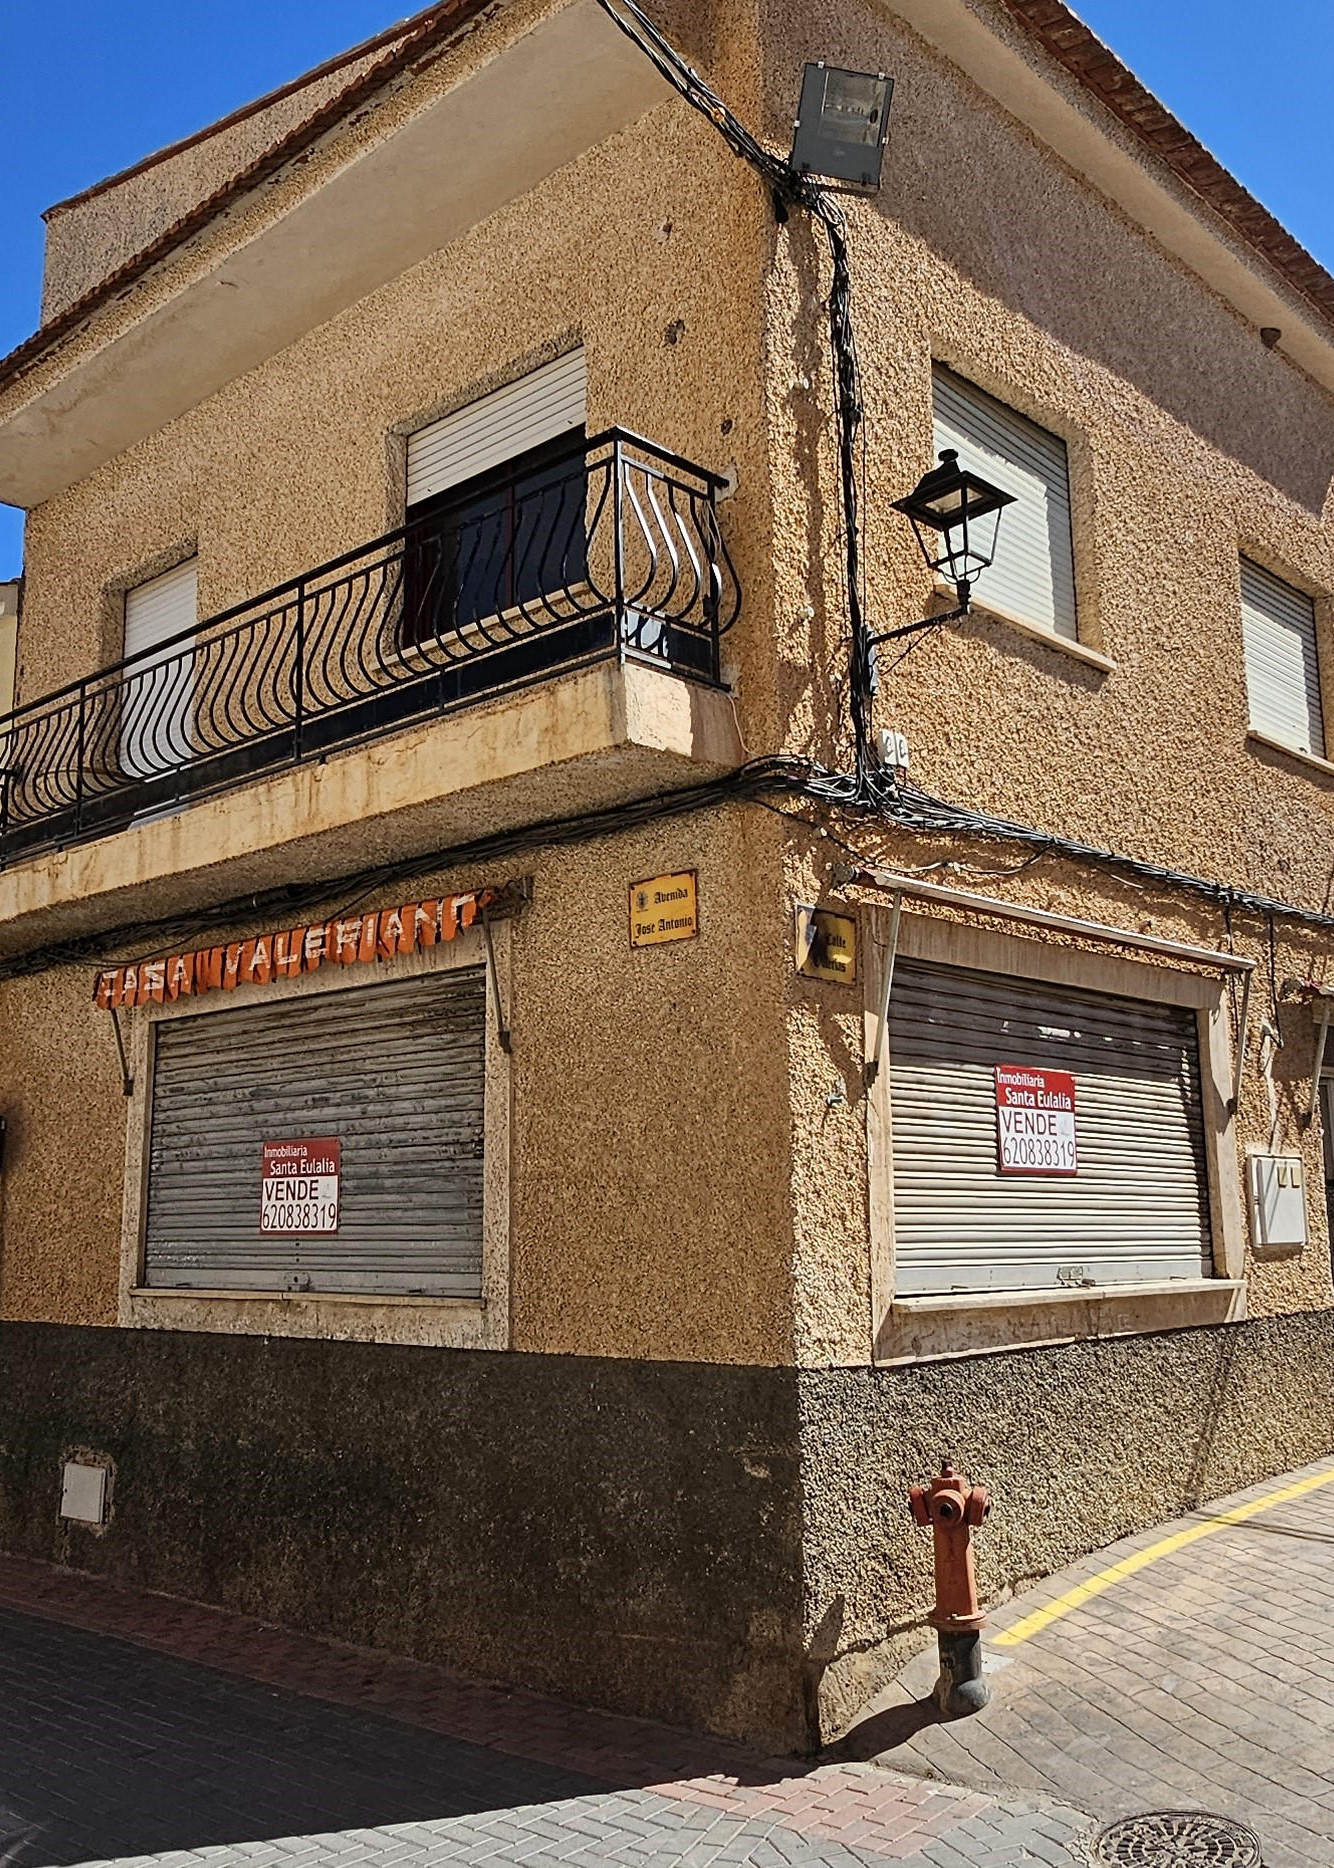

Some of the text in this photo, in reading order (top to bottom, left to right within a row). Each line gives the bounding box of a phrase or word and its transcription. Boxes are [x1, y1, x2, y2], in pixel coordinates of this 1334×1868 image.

[654, 888, 688, 904] Avenida
[658, 916, 692, 932] Antonio
[996, 1067, 1045, 1088] Inmobiliaria
[1005, 1088, 1072, 1110] Santa Eulalia
[1001, 1110, 1057, 1136] VENDE
[264, 1145, 308, 1158] Inmobiliaria
[1003, 1137, 1075, 1167] 620838319
[270, 1158, 335, 1176] Santa Eulalia
[265, 1180, 319, 1201] VENDE
[262, 1203, 336, 1229] 620838319
